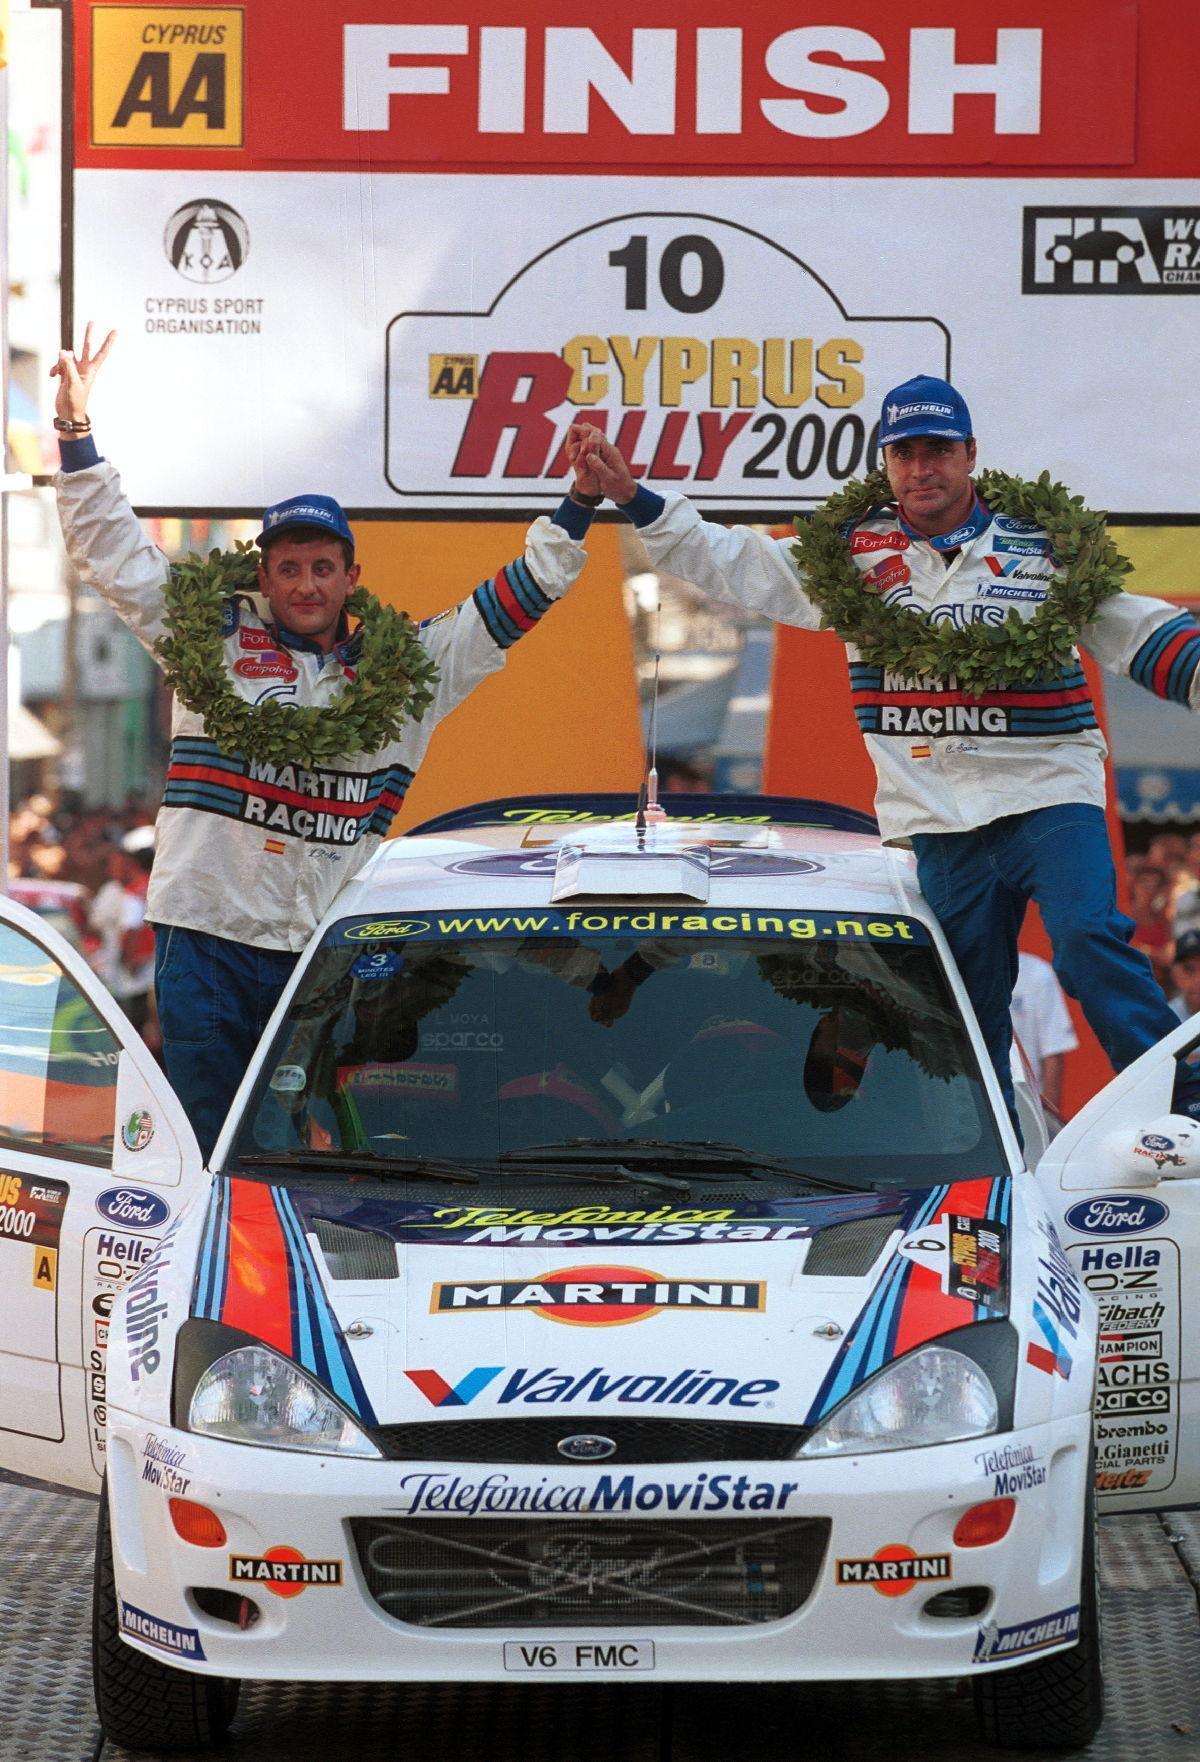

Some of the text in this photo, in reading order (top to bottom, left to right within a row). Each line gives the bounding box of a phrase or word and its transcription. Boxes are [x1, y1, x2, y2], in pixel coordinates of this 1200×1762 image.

[142, 24, 227, 45] CYPRUS
[110, 52, 227, 129] AA
[342, 24, 1043, 139] FINISH
[1034, 217, 1162, 284] FIA
[609, 234, 725, 314] 10
[145, 299, 264, 314] CYPRUS SPORT
[145, 319, 262, 334] ORGANISATION
[432, 367, 474, 394] AA
[561, 335, 865, 409] CYPRUS
[898, 403, 953, 416] MICHELIN
[280, 507, 331, 519] MICHELIN
[992, 588, 1047, 600] MICHELIN
[882, 706, 1008, 734] RACING
[248, 759, 369, 803] MARTINI
[244, 794, 358, 842] RACING
[359, 922, 413, 937] Ford
[437, 911, 914, 940] www.fordracing.net
[370, 954, 387, 967] 3
[108, 1190, 156, 1222] Ford
[1084, 1200, 1146, 1228] Ford
[462, 1221, 813, 1243] MoviStar
[977, 1229, 1000, 1253] 2000
[97, 1234, 153, 1264] Hella
[904, 1239, 946, 1251] 6
[1081, 1246, 1161, 1271] Hella
[452, 1283, 747, 1307] MARTINI
[1098, 1292, 1159, 1302] ACING
[1099, 1340, 1158, 1354] HAMPION
[497, 1366, 780, 1407] Valvoline
[1098, 1362, 1170, 1388] ACHS
[1096, 1389, 1168, 1411] parco
[1097, 1420, 1168, 1440] brembo
[1124, 1456, 1166, 1467] PARTS
[142, 1460, 191, 1495] MoviStar
[994, 1465, 1047, 1497] MoviStar
[587, 1473, 799, 1511] MoviStar
[235, 1559, 338, 1582] MARTINI
[841, 1557, 948, 1581] MARTINI
[126, 1610, 196, 1651] MICHELIN
[998, 1610, 1080, 1652] MICHELIN
[520, 1644, 639, 1667] V6 FMC
